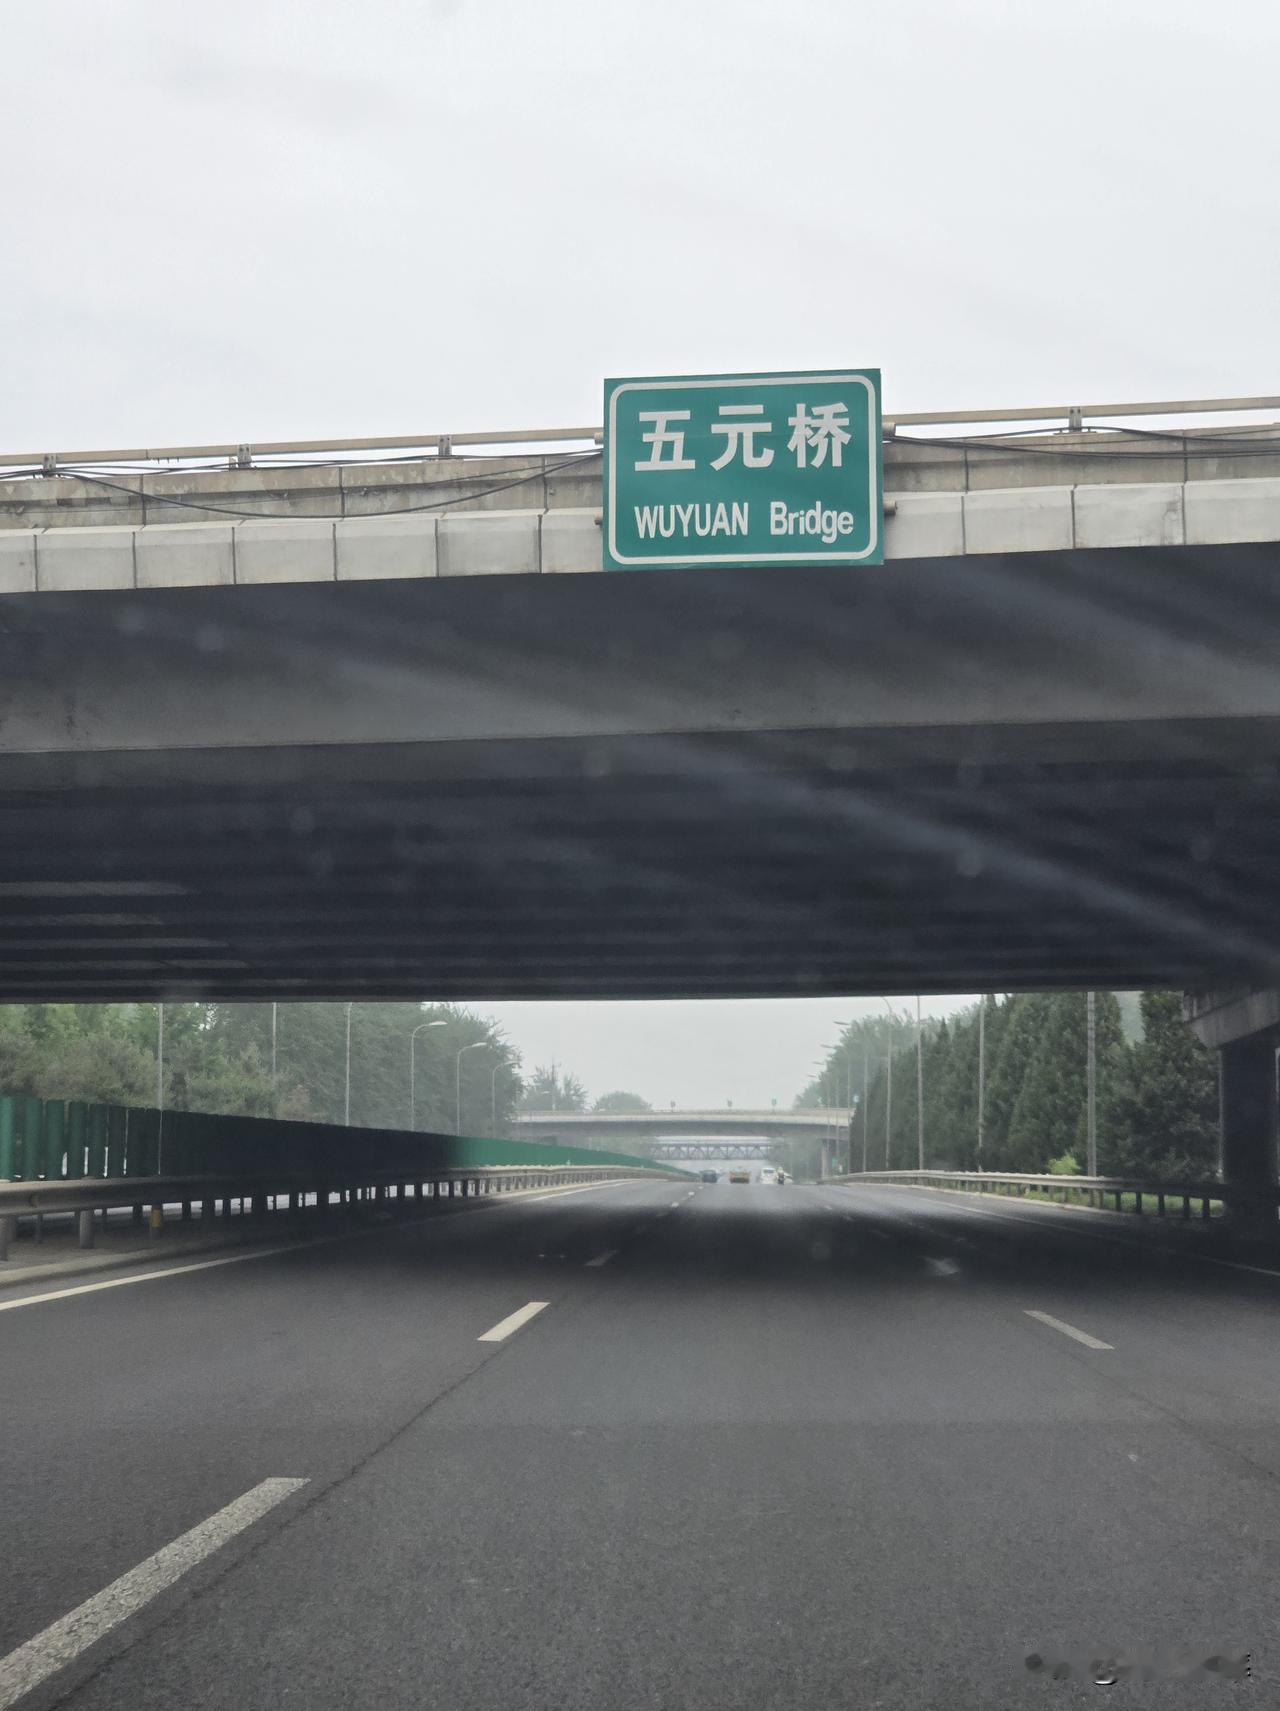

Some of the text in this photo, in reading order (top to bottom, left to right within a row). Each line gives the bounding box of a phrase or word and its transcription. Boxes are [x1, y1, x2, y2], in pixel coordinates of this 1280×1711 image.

[634, 402, 852, 472] 五元桥
[634, 500, 854, 544] WUYUAN Bridge
